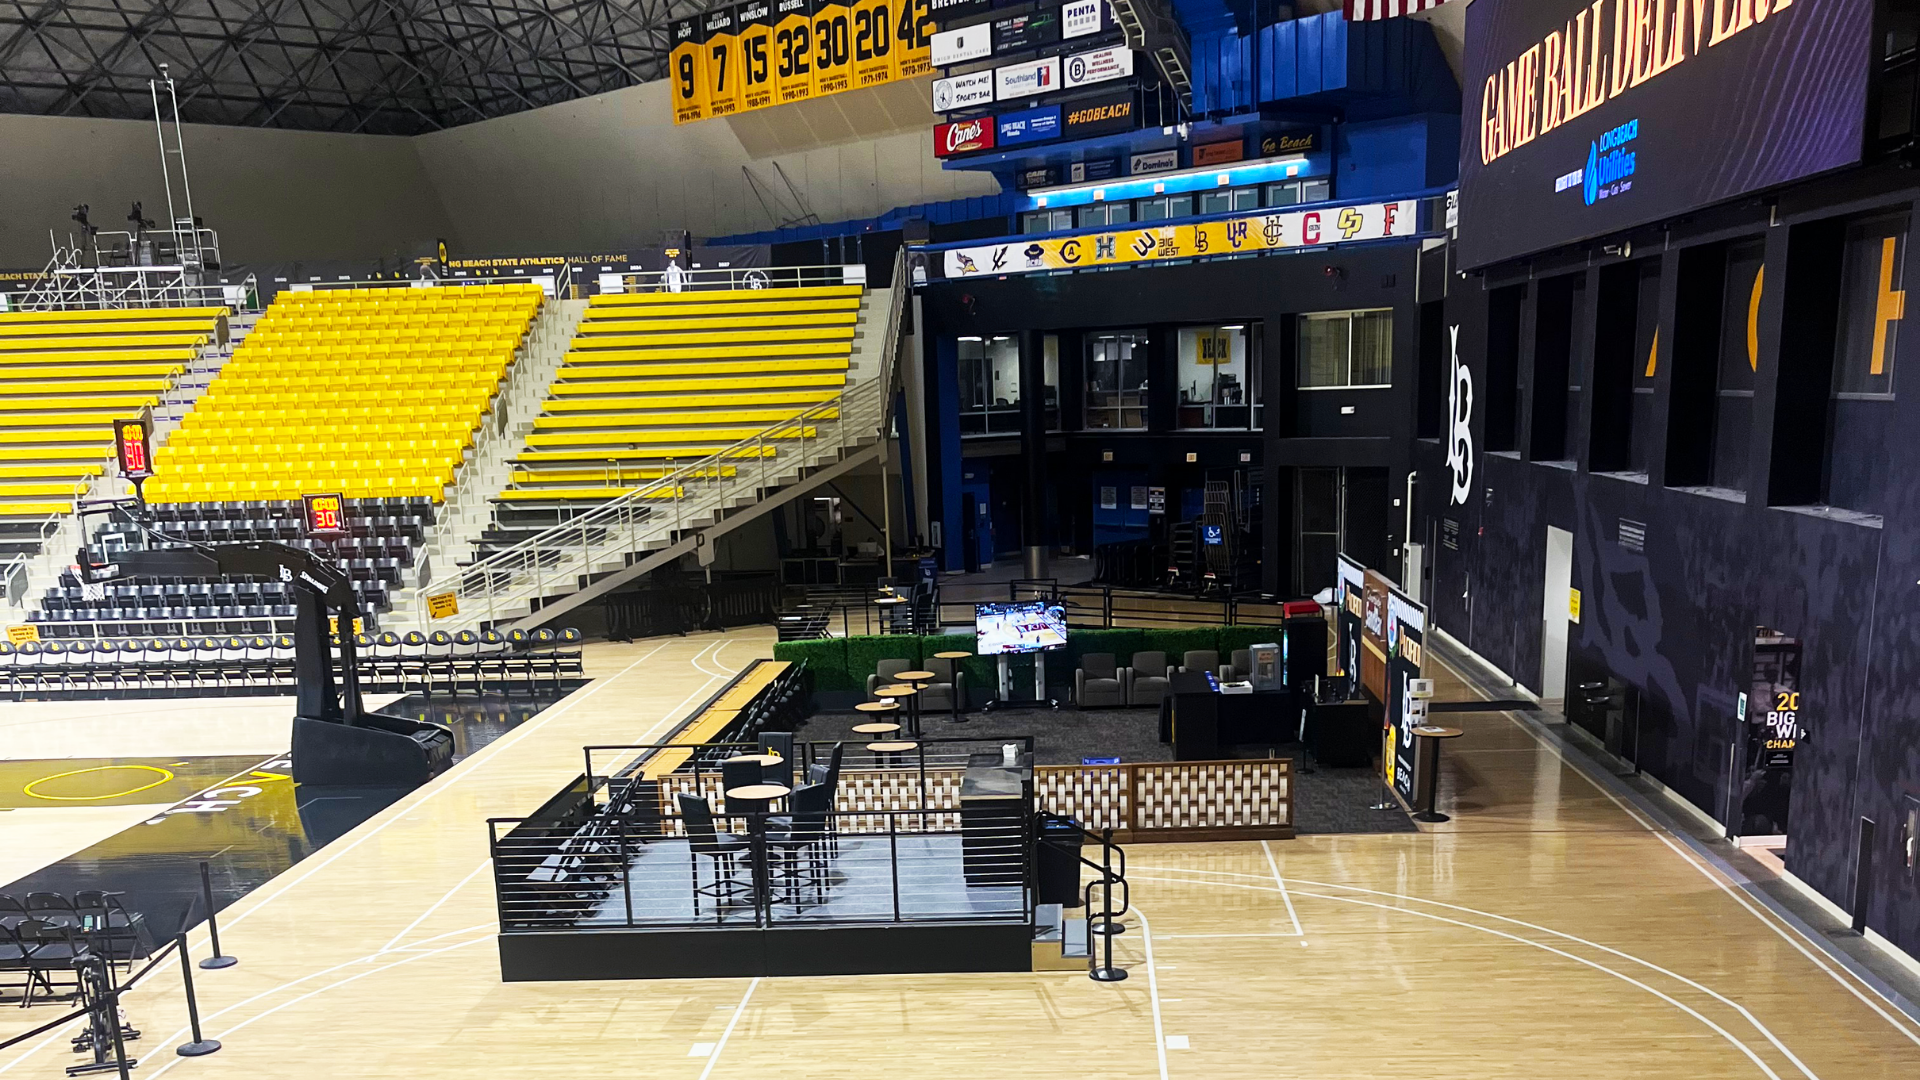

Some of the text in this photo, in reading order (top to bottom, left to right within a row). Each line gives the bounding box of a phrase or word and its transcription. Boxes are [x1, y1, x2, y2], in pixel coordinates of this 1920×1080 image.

[779, 0, 804, 12] RUSSELL
[1068, 4, 1096, 19] PENTA
[740, 7, 768, 22] WINSLOW
[706, 17, 730, 31] HILLIARD
[897, 0, 931, 50] 42
[678, 27, 692, 39] HOFF
[856, 5, 890, 62] 20
[816, 15, 849, 70] 30
[777, 25, 810, 77] 32
[1093, 51, 1112, 59] HEALING
[744, 35, 768, 85] 15
[1092, 58, 1114, 66] WELLNESS
[713, 44, 727, 92] 7
[902, 62, 931, 75] 1970-1973
[1074, 64, 1081, 76] B
[1087, 64, 1119, 75] PERFORMANCE
[680, 54, 694, 99] 9
[861, 73, 888, 85] 1971-1974
[956, 76, 989, 89] WATCH ME!
[1005, 72, 1036, 86] Southland
[1481, 0, 1796, 166] GAME BALL DELI
[821, 80, 848, 93] 1990-1993
[782, 88, 809, 101] 1990-1993
[956, 90, 990, 103] SPORTS BAR
[1068, 102, 1131, 125] #GOBEACH
[1012, 119, 1026, 130] BEACH
[947, 120, 983, 152] Cane's
[1262, 134, 1313, 153] Go Beach
[1143, 158, 1174, 171] Domino's
[1598, 147, 1636, 187] Utilities
[1383, 203, 1399, 236] F
[1158, 238, 1173, 247] BIG
[1158, 246, 1181, 257] WEST
[463, 259, 491, 268] BEACH
[520, 257, 565, 266] ATHLETICS
[568, 256, 589, 264] HALL
[605, 255, 628, 263] FAME
[125, 442, 145, 470] 30
[316, 511, 336, 527] 30
[300, 571, 329, 594] SPALDING
[1767, 711, 1795, 726] BIG
[1396, 766, 1411, 793] BEACH
